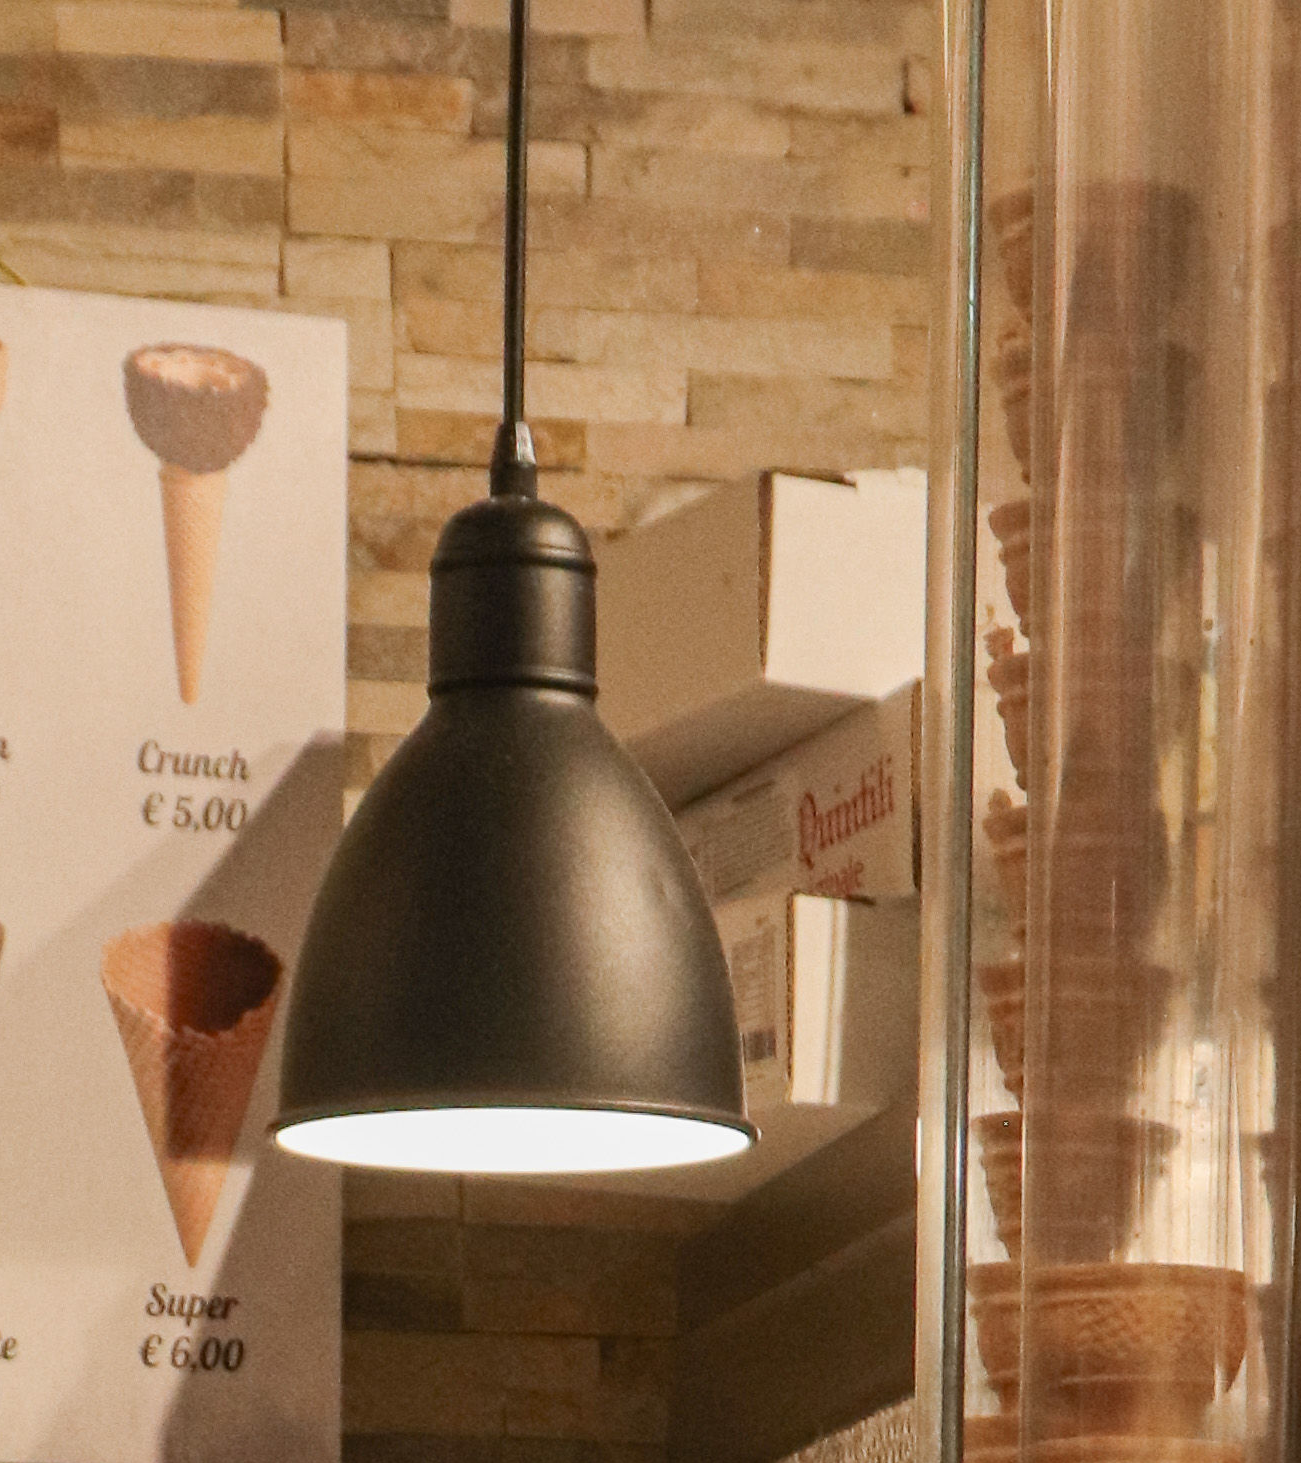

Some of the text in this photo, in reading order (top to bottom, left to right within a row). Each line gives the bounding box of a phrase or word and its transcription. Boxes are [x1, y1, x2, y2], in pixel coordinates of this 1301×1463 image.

[137, 741, 250, 783] Crunch
[141, 794, 247, 832] € 5,00
[145, 1283, 239, 1327] Super
[139, 1335, 246, 1373] € 6,00
